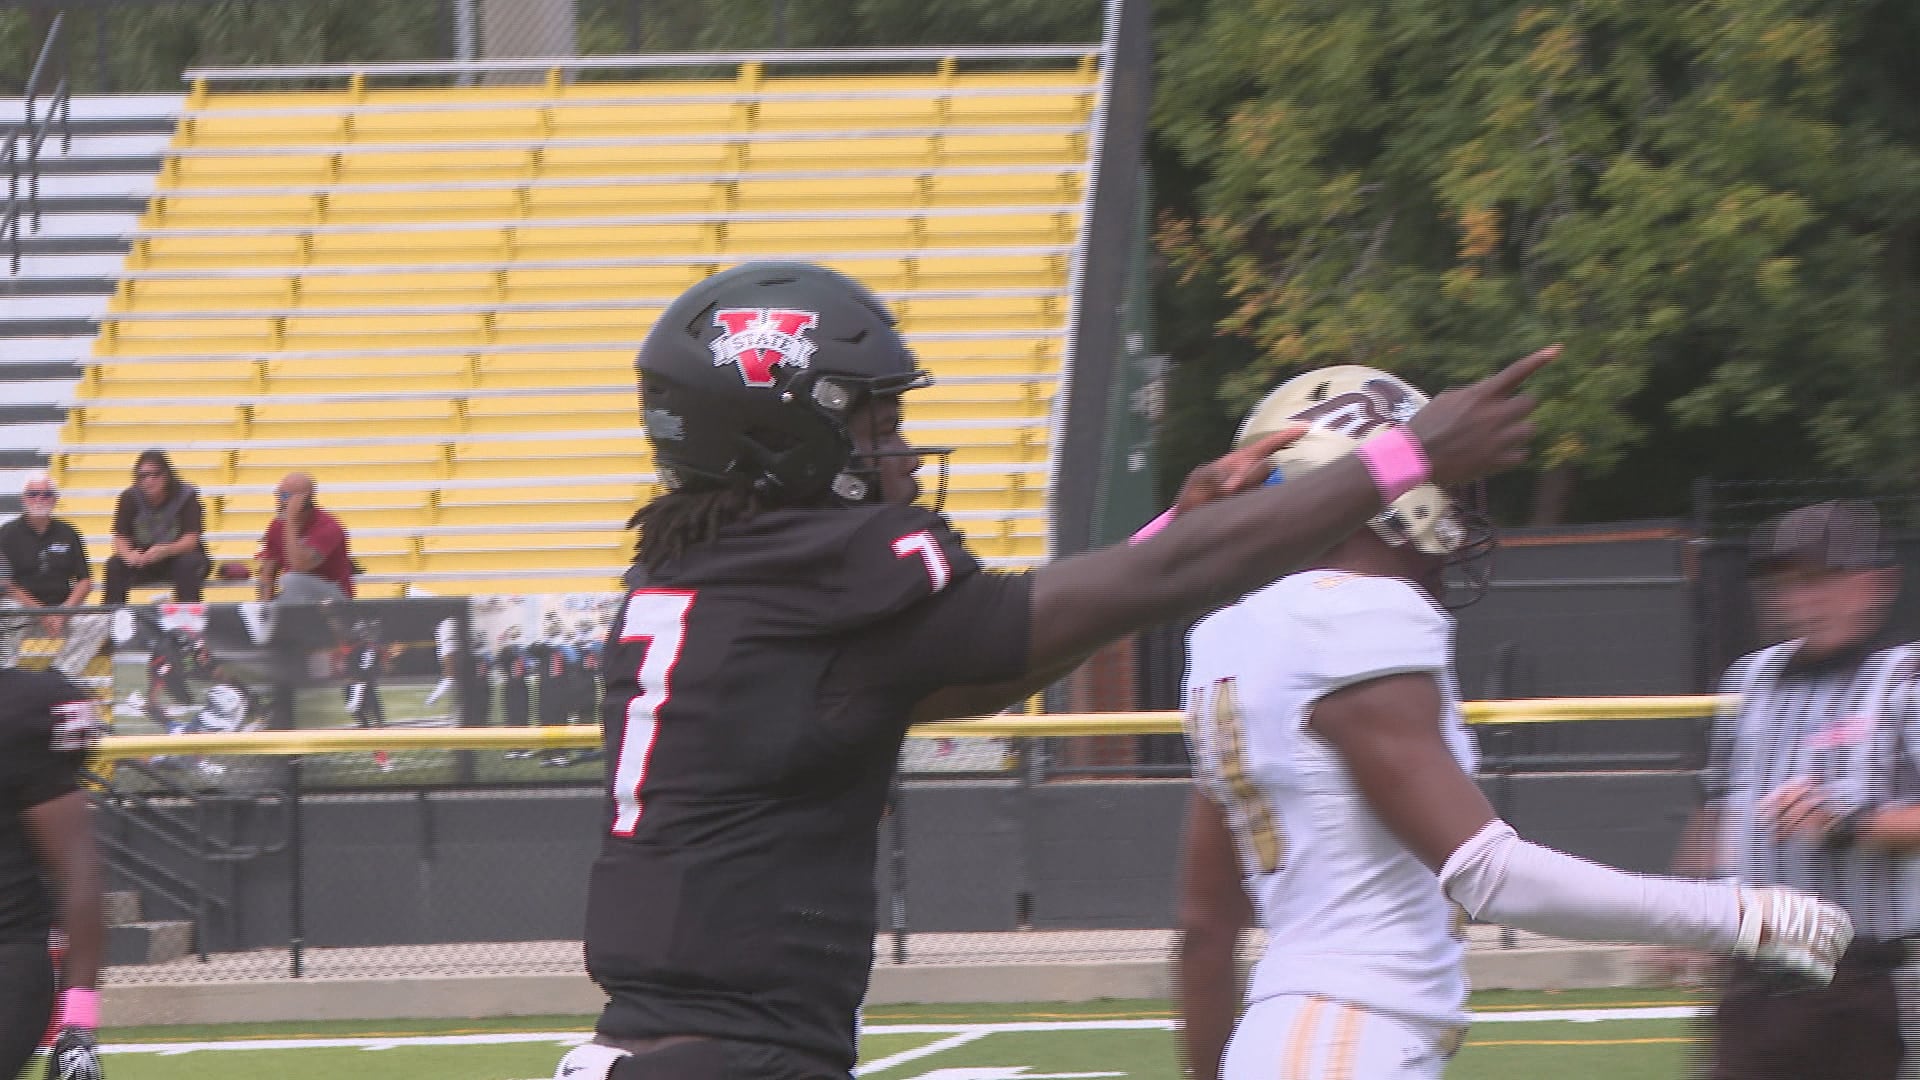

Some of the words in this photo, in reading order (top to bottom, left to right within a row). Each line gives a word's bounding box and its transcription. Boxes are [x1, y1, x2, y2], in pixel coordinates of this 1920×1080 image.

[713, 307, 820, 388] V
[733, 331, 796, 353] STATE
[890, 529, 953, 593] 7
[611, 587, 699, 837] 7
